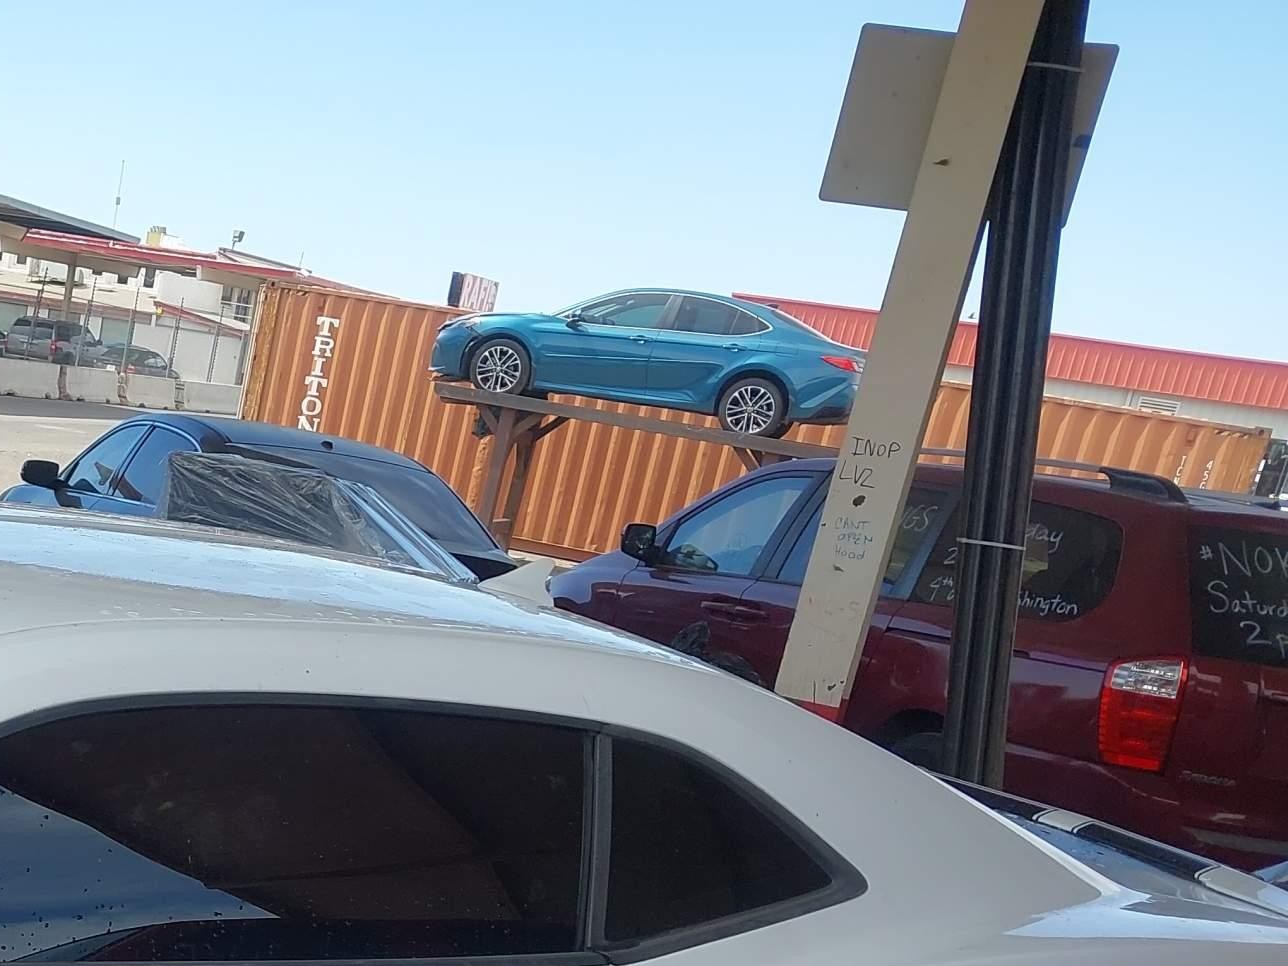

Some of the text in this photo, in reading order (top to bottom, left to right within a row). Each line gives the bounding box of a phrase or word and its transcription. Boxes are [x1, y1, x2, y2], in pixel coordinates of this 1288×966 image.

[297, 316, 340, 432] TRITON
[852, 436, 901, 458] INOP
[1239, 620, 1273, 645] 2
